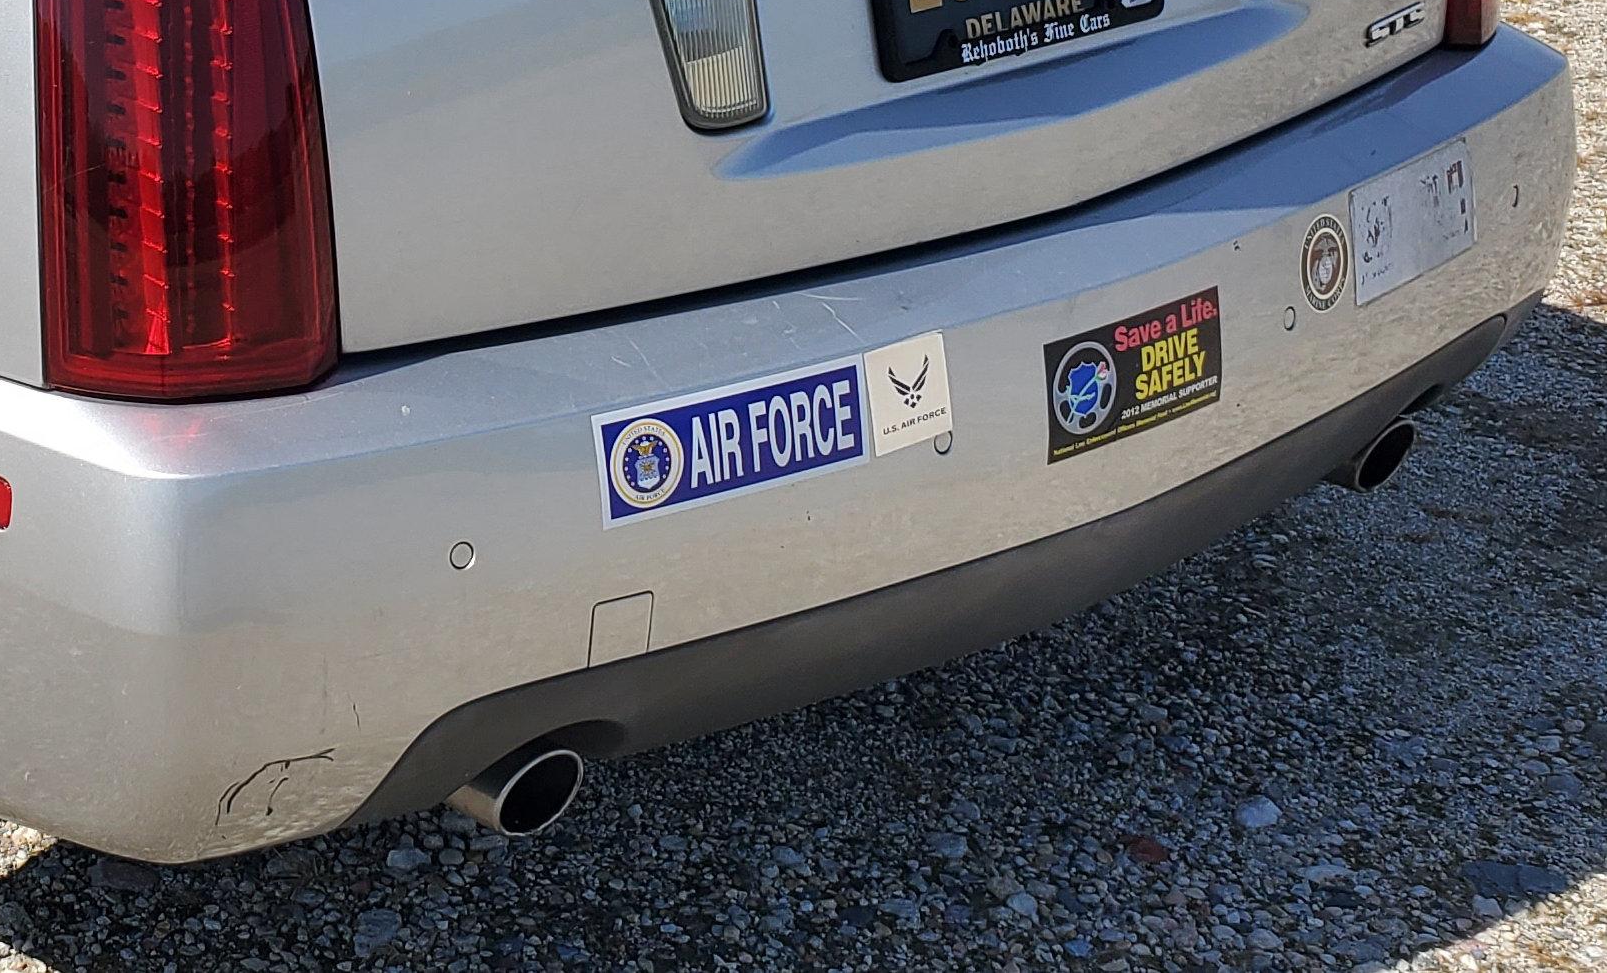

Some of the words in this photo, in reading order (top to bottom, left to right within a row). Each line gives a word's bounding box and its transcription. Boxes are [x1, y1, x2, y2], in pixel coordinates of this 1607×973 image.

[961, 28, 1039, 63] Rehoboth's
[1043, 21, 1075, 43] Fine
[1079, 13, 1111, 34] Cars
[1365, 2, 1426, 44] STS
[1114, 320, 1162, 352] Save
[1165, 314, 1177, 334] a
[1180, 297, 1218, 328] Life.
[1141, 328, 1199, 372] DRIVE
[1121, 405, 1140, 420] 2012
[1141, 392, 1178, 413] MEMORIAL
[1178, 375, 1218, 399] SUPPORTER
[1135, 351, 1206, 401] SAFELY
[690, 408, 744, 489] AIR
[748, 379, 855, 473] FORCE
[883, 424, 900, 435] U.S.
[901, 418, 916, 429] AIR
[917, 407, 947, 423] FORCE
